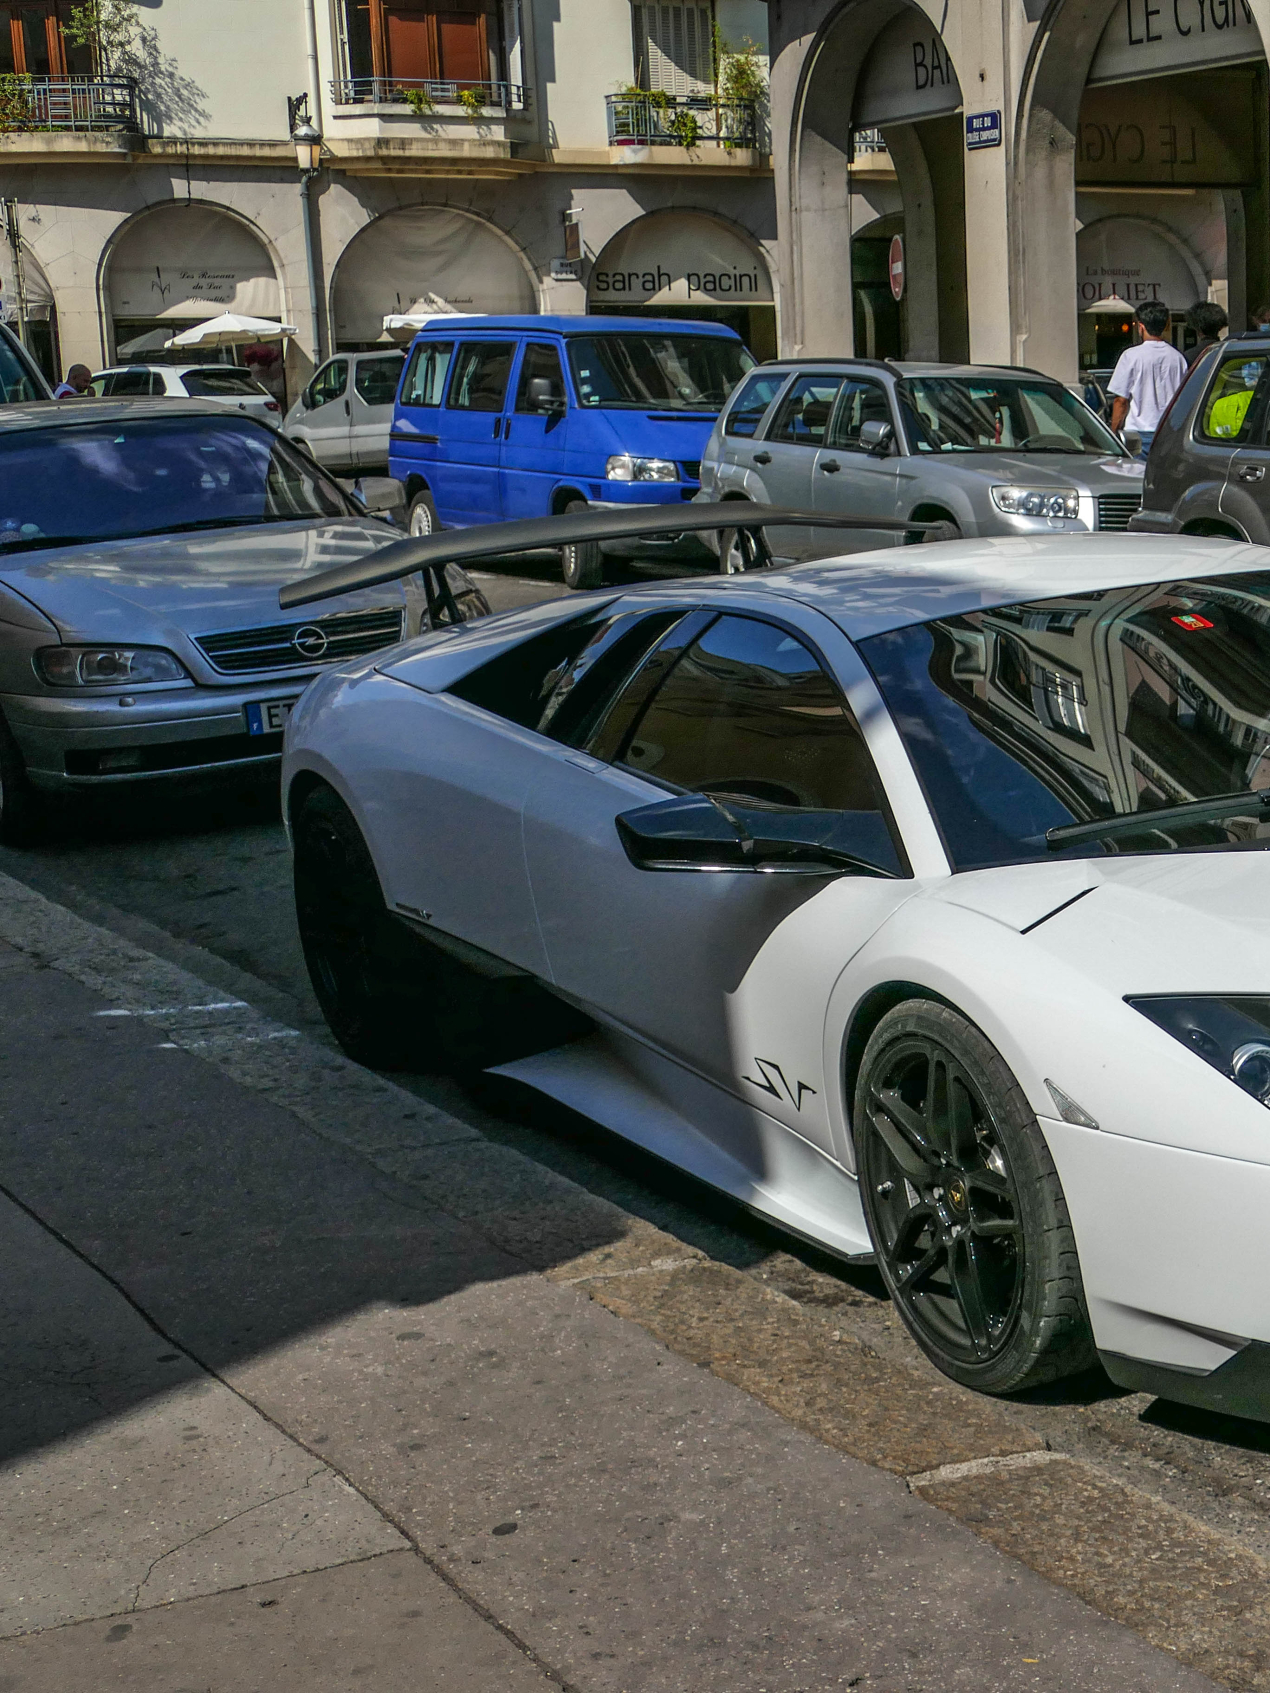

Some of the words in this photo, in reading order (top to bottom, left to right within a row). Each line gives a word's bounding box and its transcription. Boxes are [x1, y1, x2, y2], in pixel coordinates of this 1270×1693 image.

[1127, 0, 1162, 45] LE
[973, 117, 983, 129] RUE
[984, 116, 992, 127] DU
[1086, 266, 1098, 276] La
[1101, 266, 1141, 278] boutique
[596, 265, 671, 292] sarah
[687, 266, 758, 299] pacini
[1077, 282, 1161, 301] OLLIET
